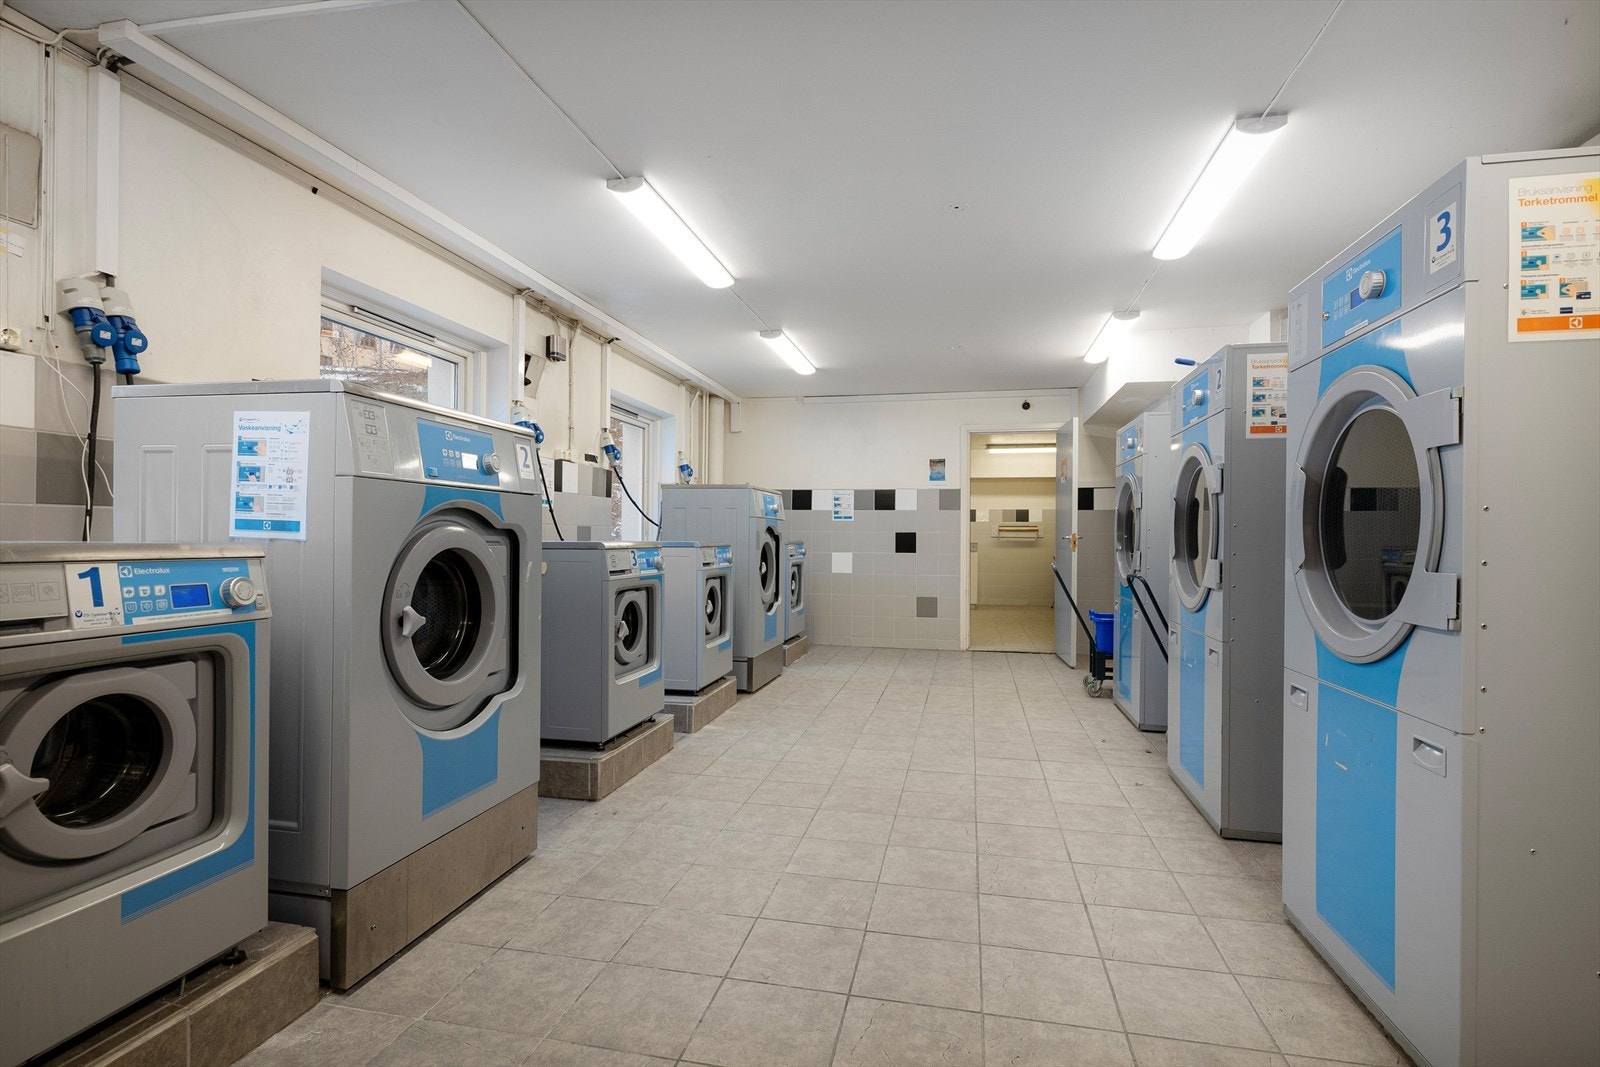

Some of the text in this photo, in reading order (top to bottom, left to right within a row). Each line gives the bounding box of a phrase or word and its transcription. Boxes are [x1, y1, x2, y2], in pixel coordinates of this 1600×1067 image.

[1518, 184, 1593, 197] Bruksanvisning
[1436, 211, 1452, 252] 3
[1217, 369, 1222, 389] 2
[520, 446, 531, 469] 2
[630, 550, 637, 566] 3
[134, 567, 170, 575] Electrolux
[77, 567, 104, 607] 1
